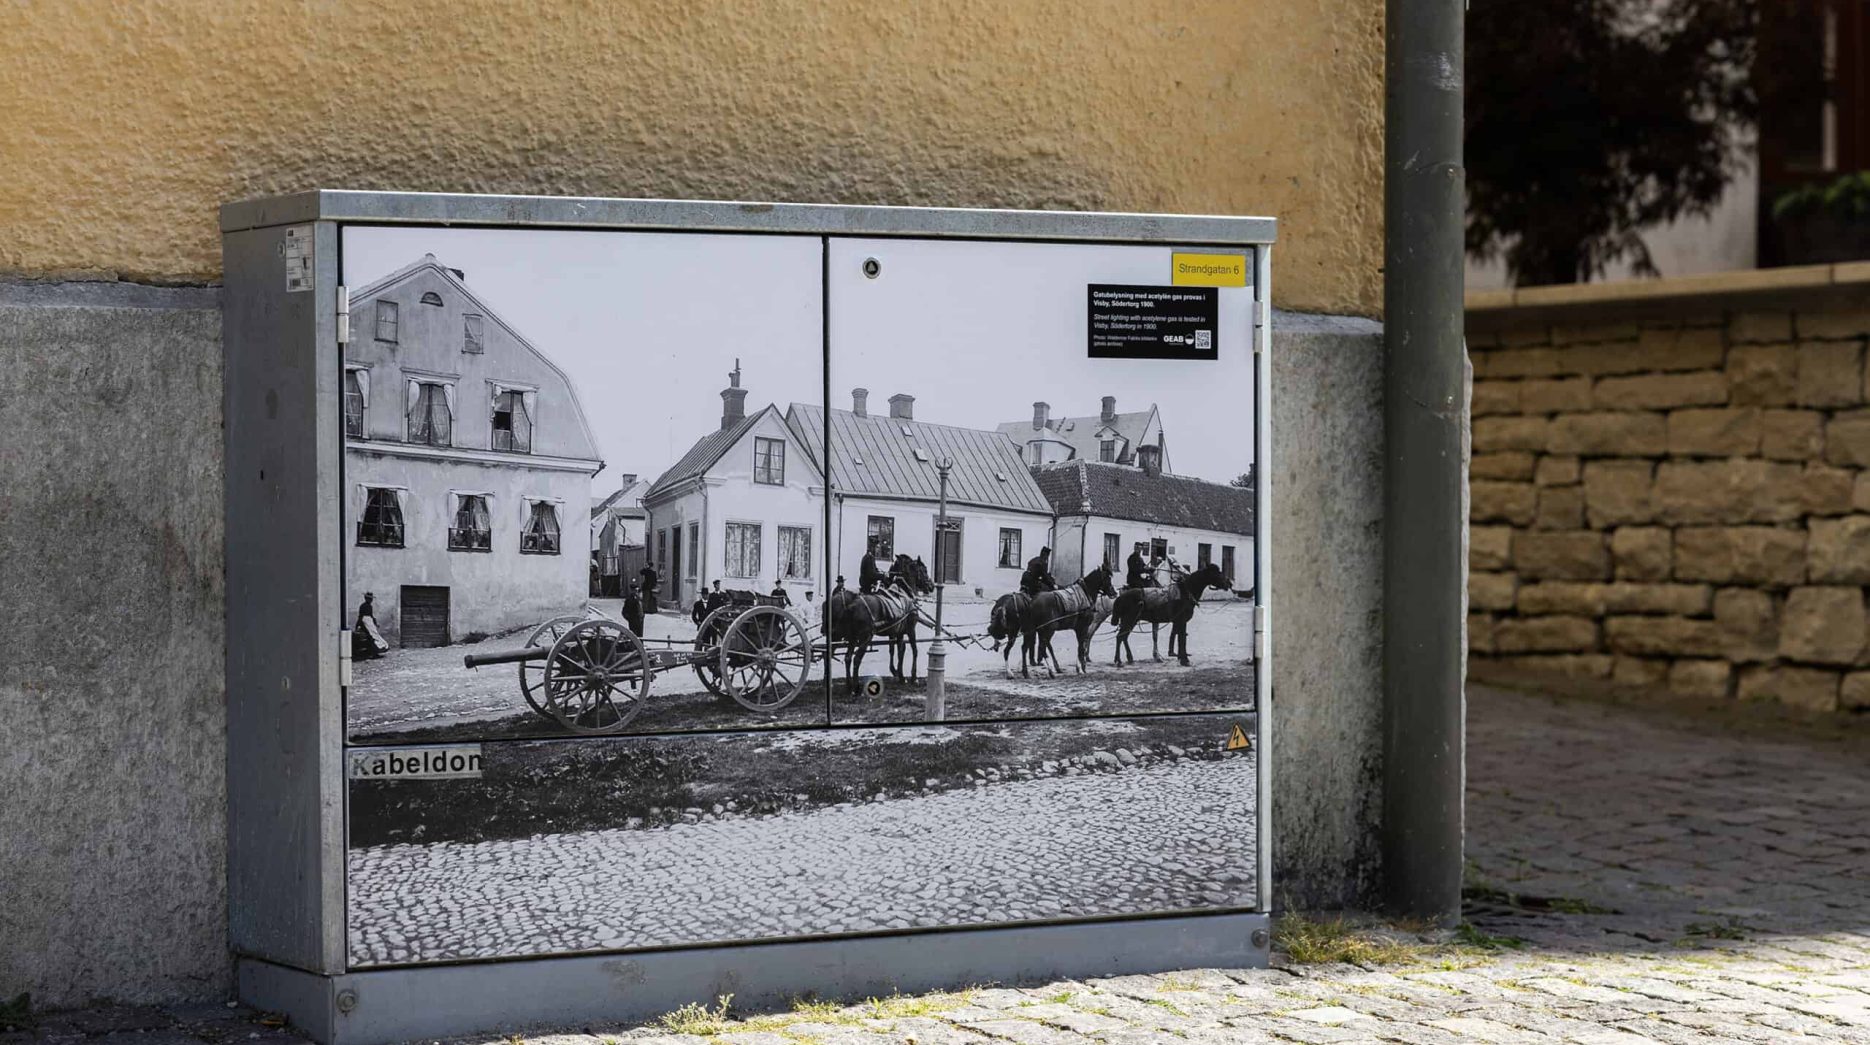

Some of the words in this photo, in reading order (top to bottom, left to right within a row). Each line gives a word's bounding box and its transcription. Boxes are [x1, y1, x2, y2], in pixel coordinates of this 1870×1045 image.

[1178, 263, 1231, 276] Strandgatan
[1234, 266, 1240, 275] 6
[1093, 291, 1134, 300] Gatubelysning
[1111, 300, 1140, 308] Södertorg
[1110, 314, 1129, 322] lighting
[353, 750, 482, 776] Kabeldon
